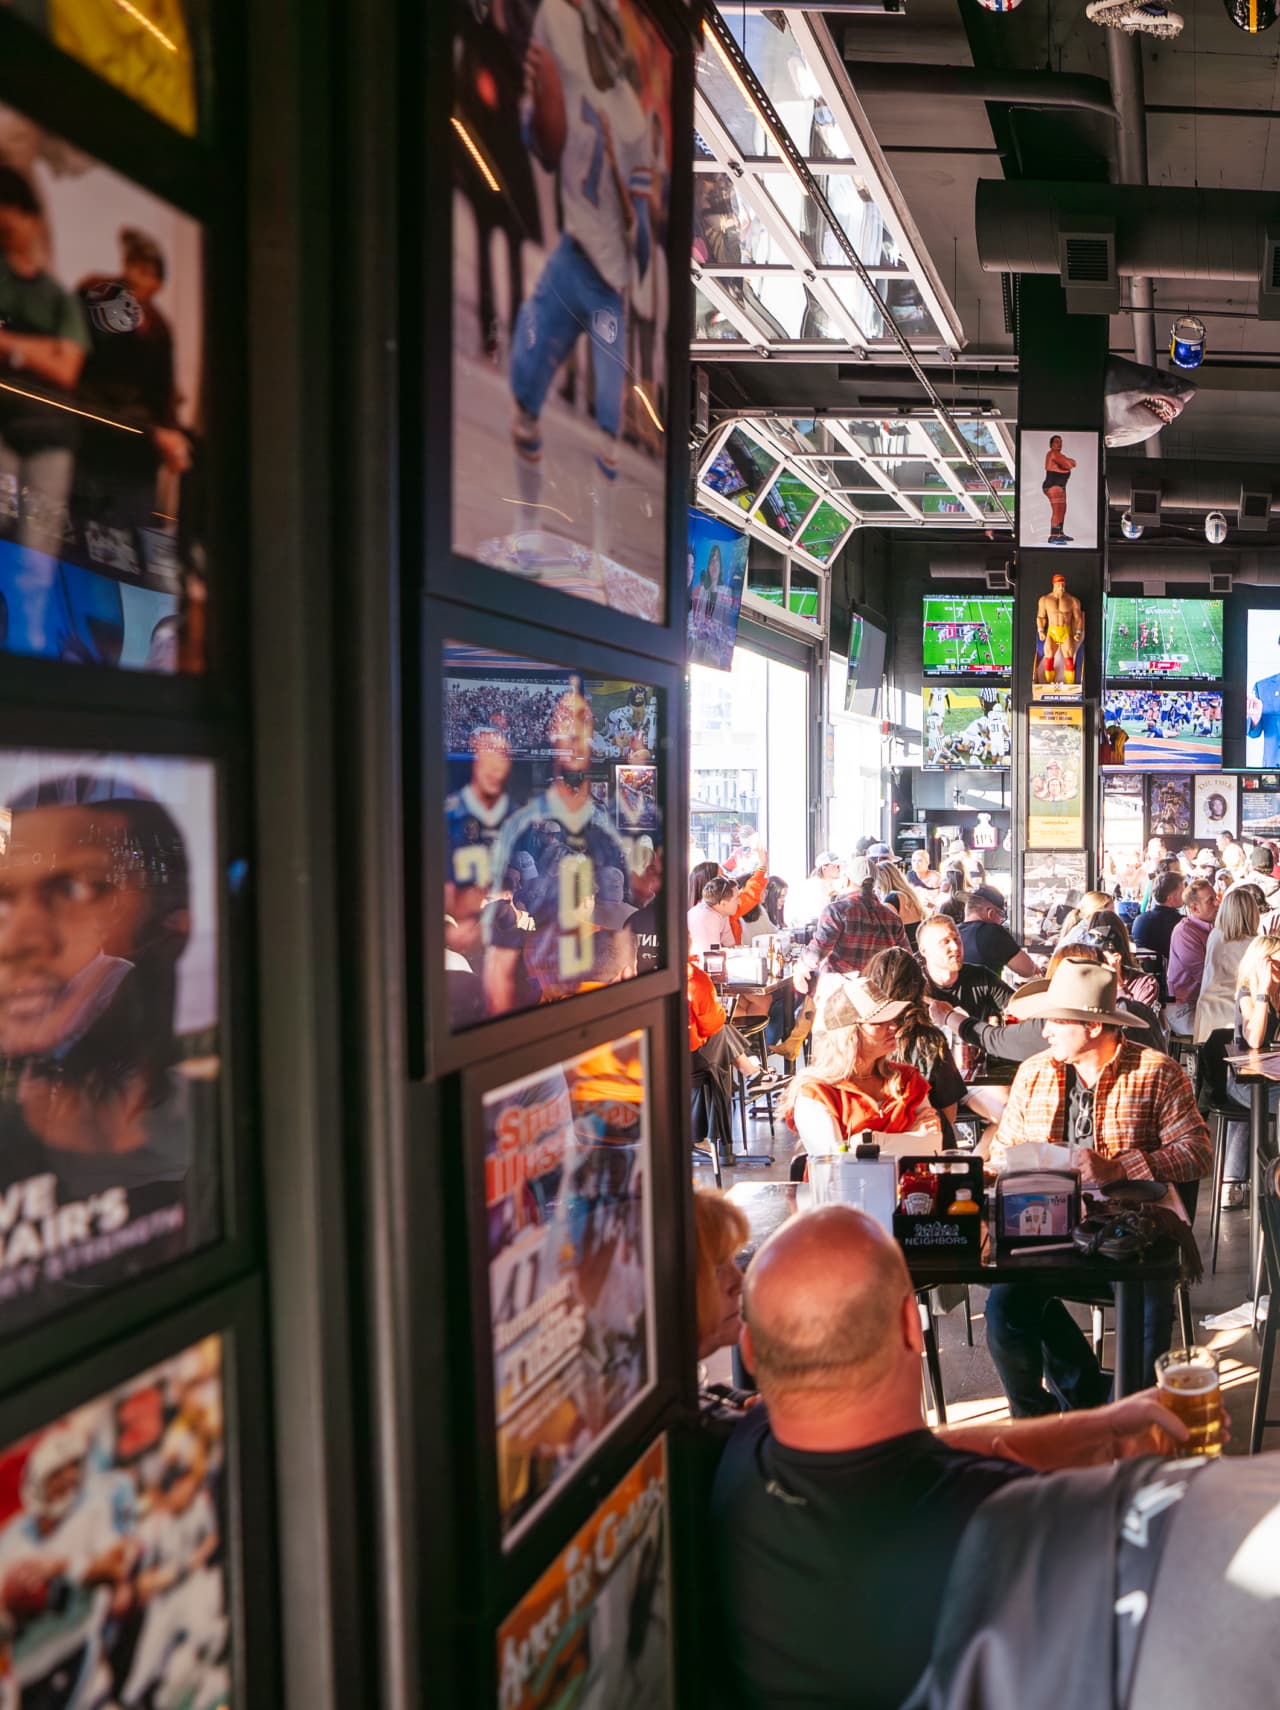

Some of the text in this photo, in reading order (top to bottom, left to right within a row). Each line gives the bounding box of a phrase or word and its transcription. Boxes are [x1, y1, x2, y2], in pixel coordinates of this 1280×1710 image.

[558, 854, 594, 979] 9
[0, 1186, 128, 1266] AIR'S
[905, 1236, 968, 1246] NEIGHBORS
